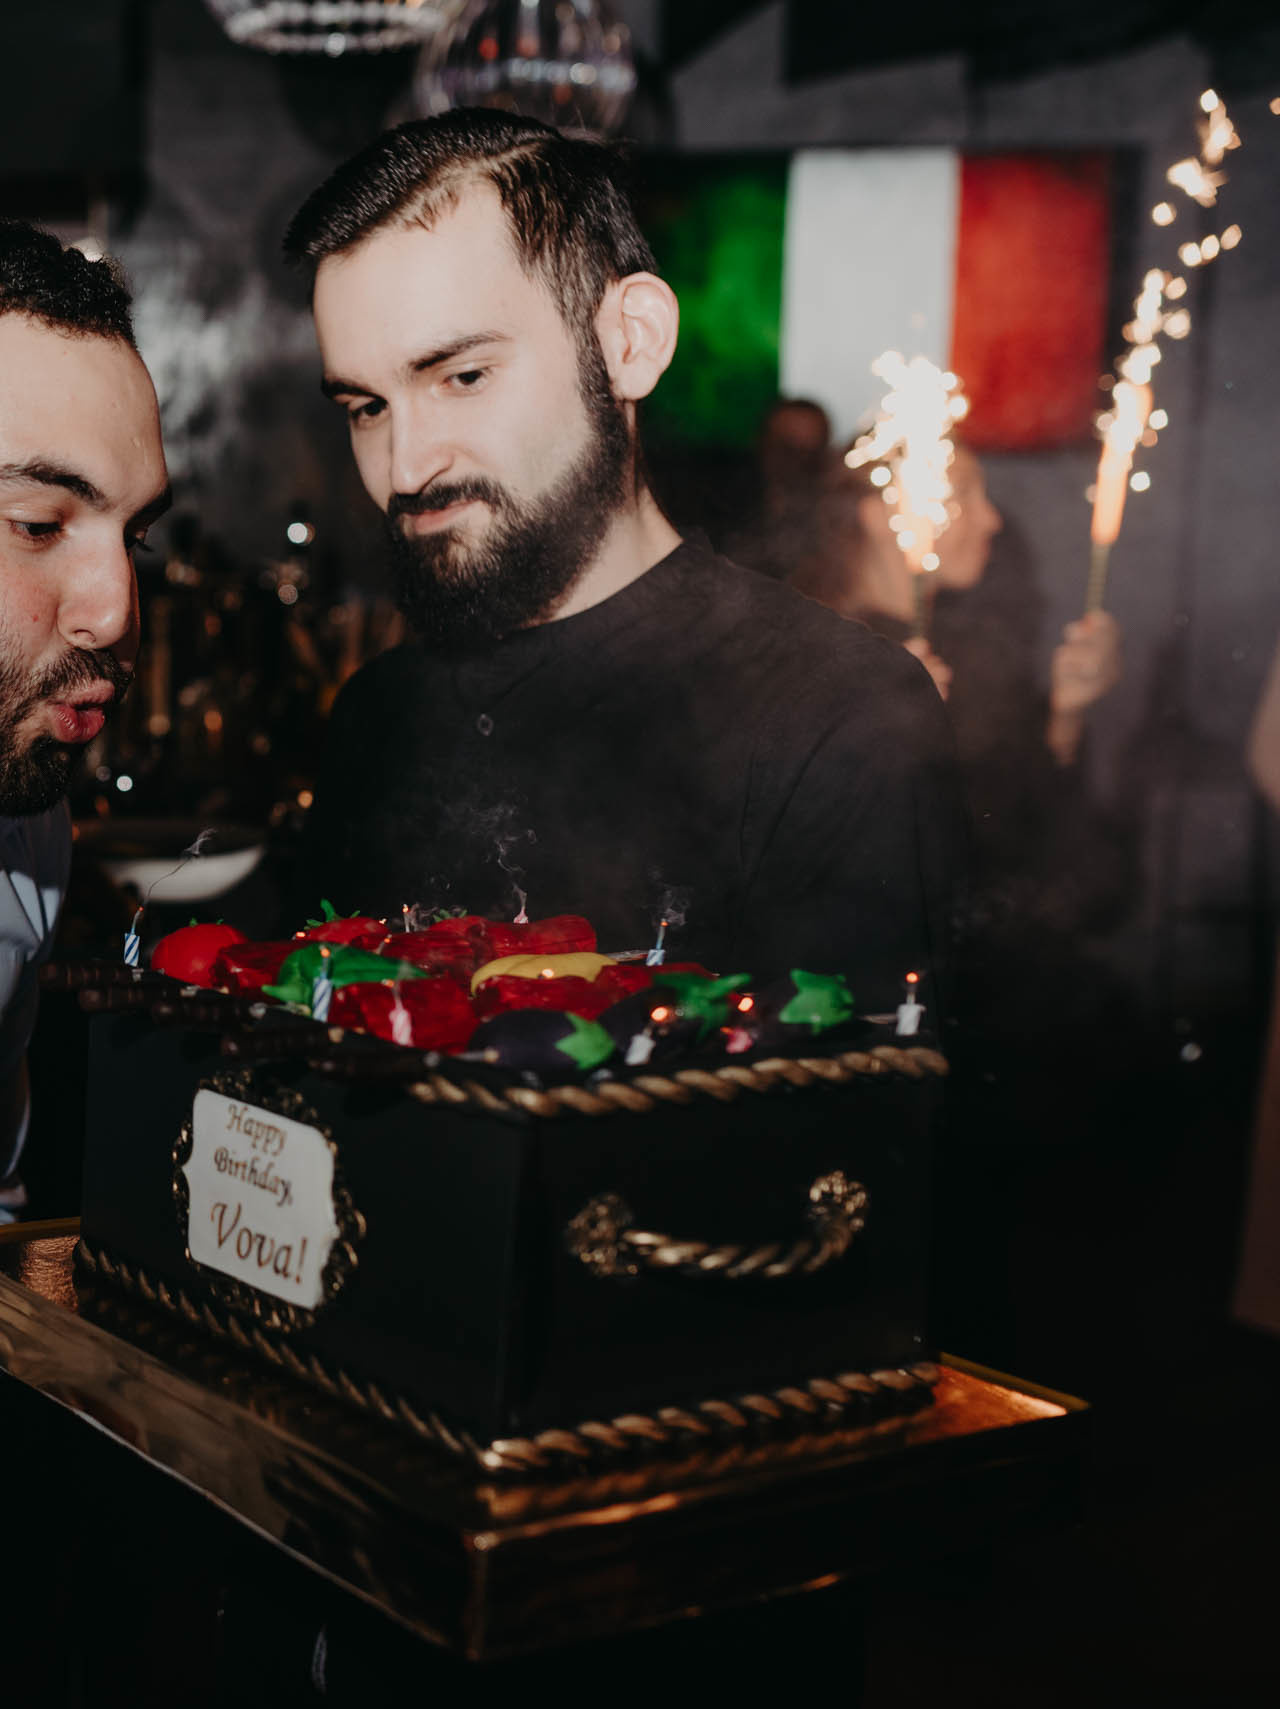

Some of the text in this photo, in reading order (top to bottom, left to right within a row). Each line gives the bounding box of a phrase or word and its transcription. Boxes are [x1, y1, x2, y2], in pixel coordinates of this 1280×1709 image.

[226, 1103, 288, 1157] Happy
[214, 1147, 294, 1207] Birthday,
[210, 1201, 308, 1285] Vova!
